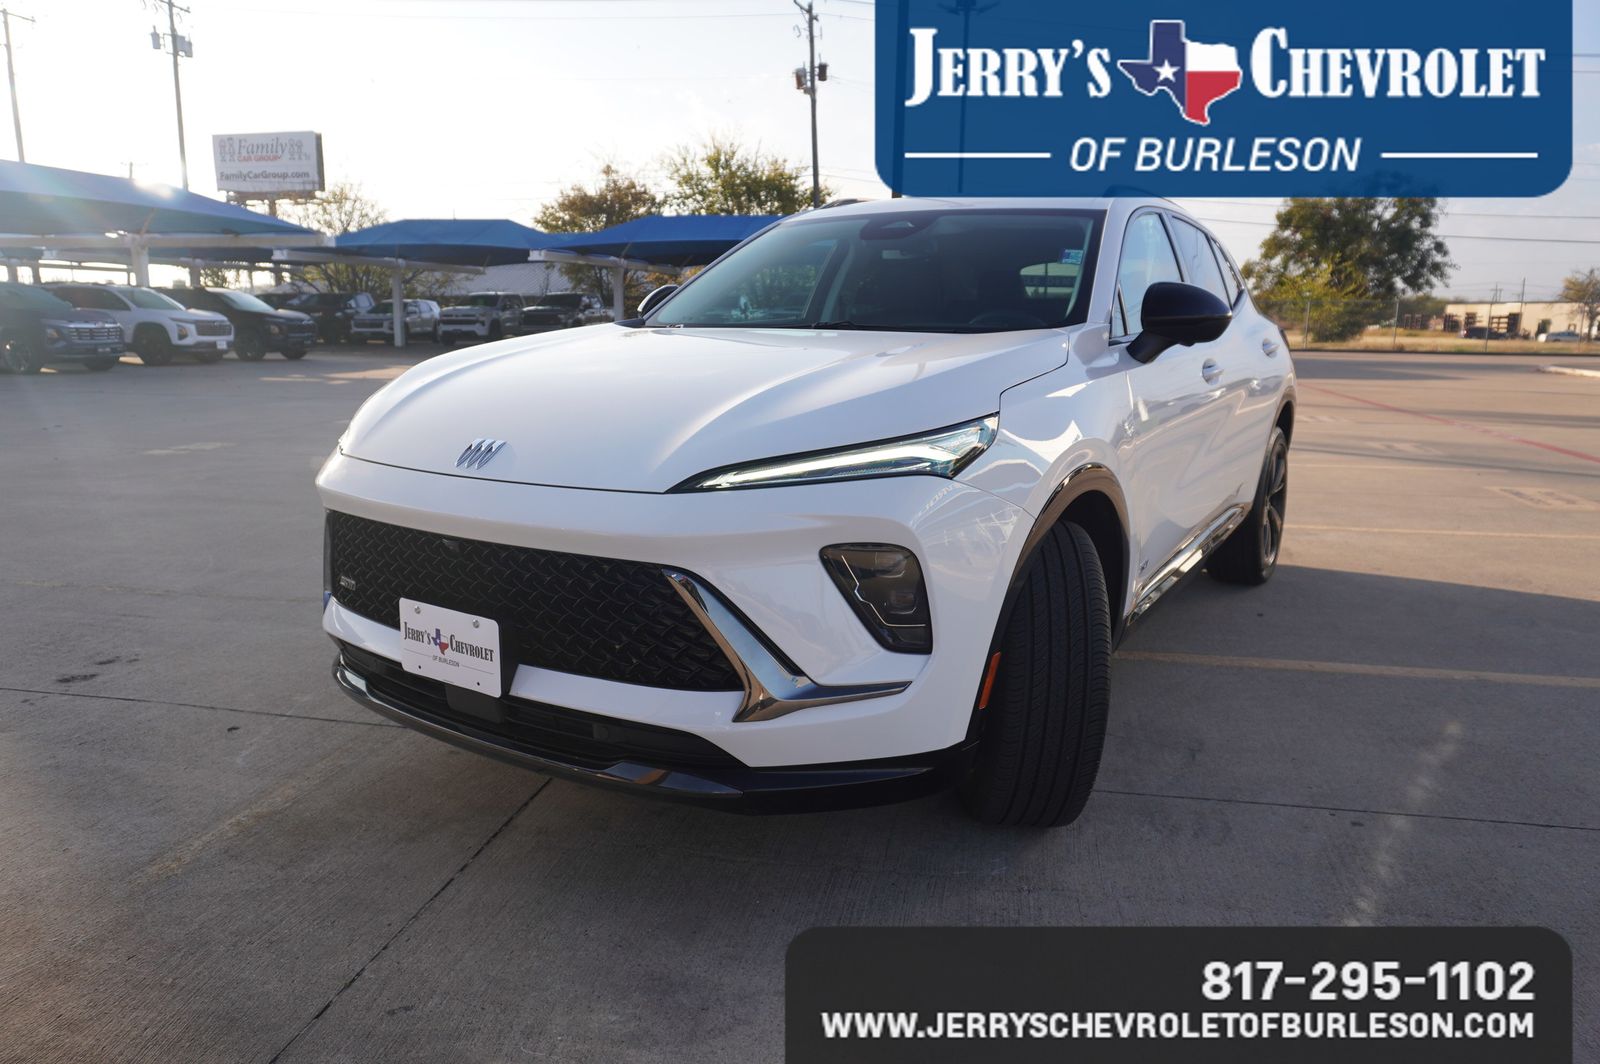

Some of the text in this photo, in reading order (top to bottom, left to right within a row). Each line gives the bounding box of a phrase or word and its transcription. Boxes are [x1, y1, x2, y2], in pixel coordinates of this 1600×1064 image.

[237, 137, 288, 155] Family
[220, 170, 310, 181] FamilyCarGroup.com
[449, 634, 495, 662] CHEVROLET
[432, 654, 438, 662] OF
